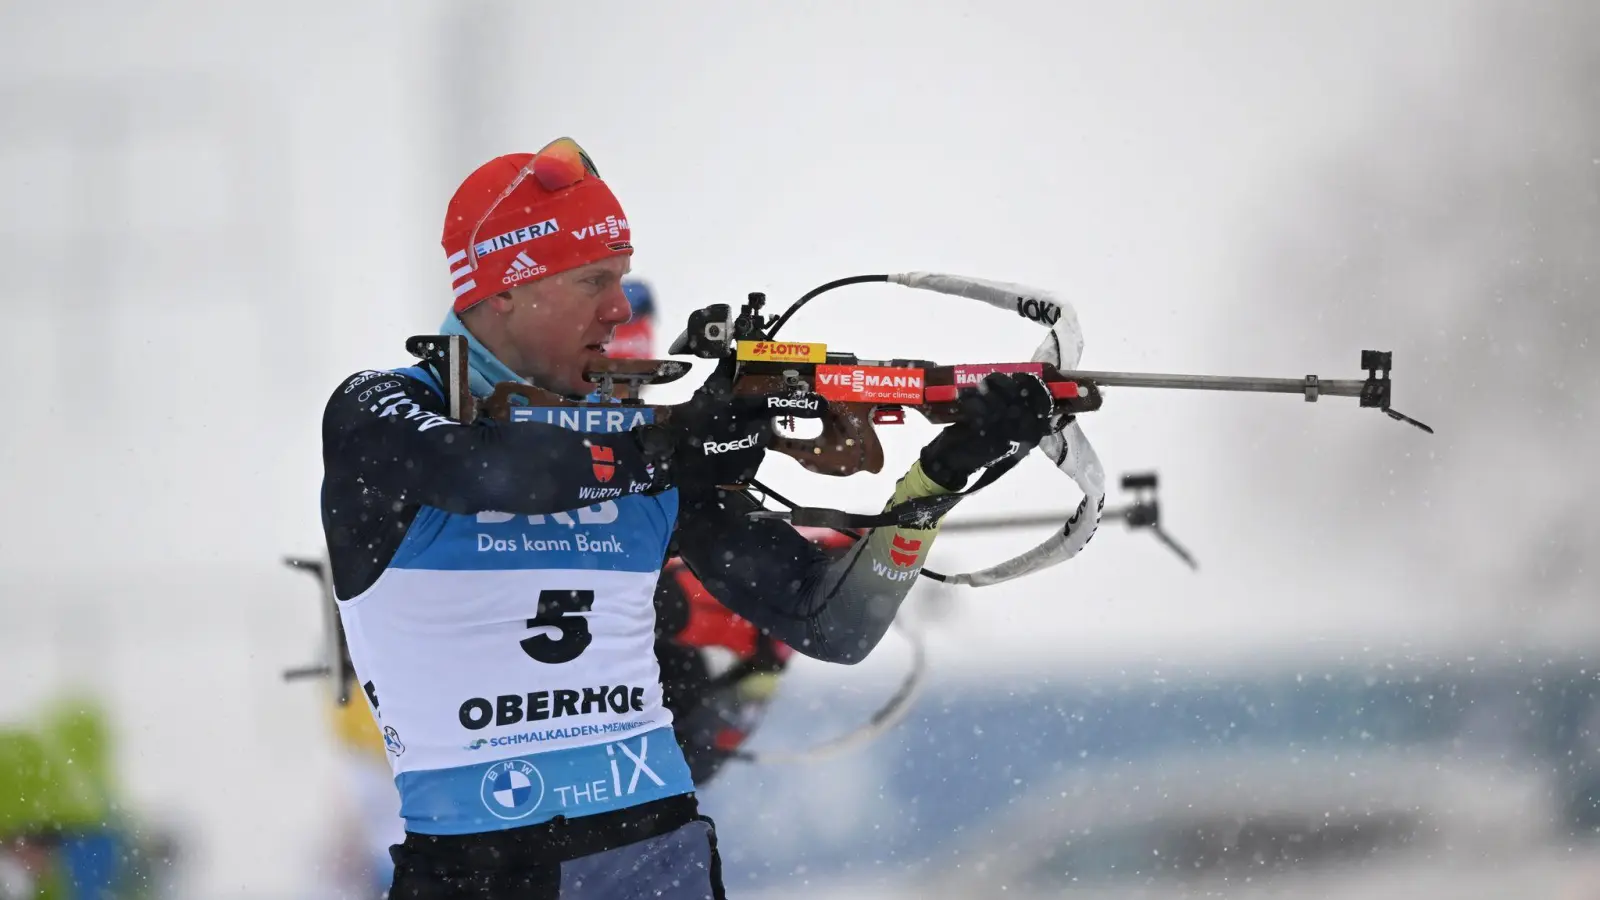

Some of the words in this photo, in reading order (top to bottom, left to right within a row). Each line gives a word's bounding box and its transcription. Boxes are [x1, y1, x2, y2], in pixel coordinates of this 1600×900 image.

[475, 221, 557, 257] E.INFRA
[502, 264, 547, 285] adidas
[770, 344, 811, 356] LOTTO
[819, 369, 921, 393] VIESSMANN
[893, 391, 921, 400] climate
[514, 409, 645, 432] EINFRA
[579, 486, 622, 499] WÜRTH
[476, 533, 517, 552] Das
[523, 533, 571, 552] kann
[576, 533, 624, 553] Bank
[872, 558, 923, 582] WÜRTH
[519, 590, 595, 664] 5
[553, 780, 609, 807] THE
